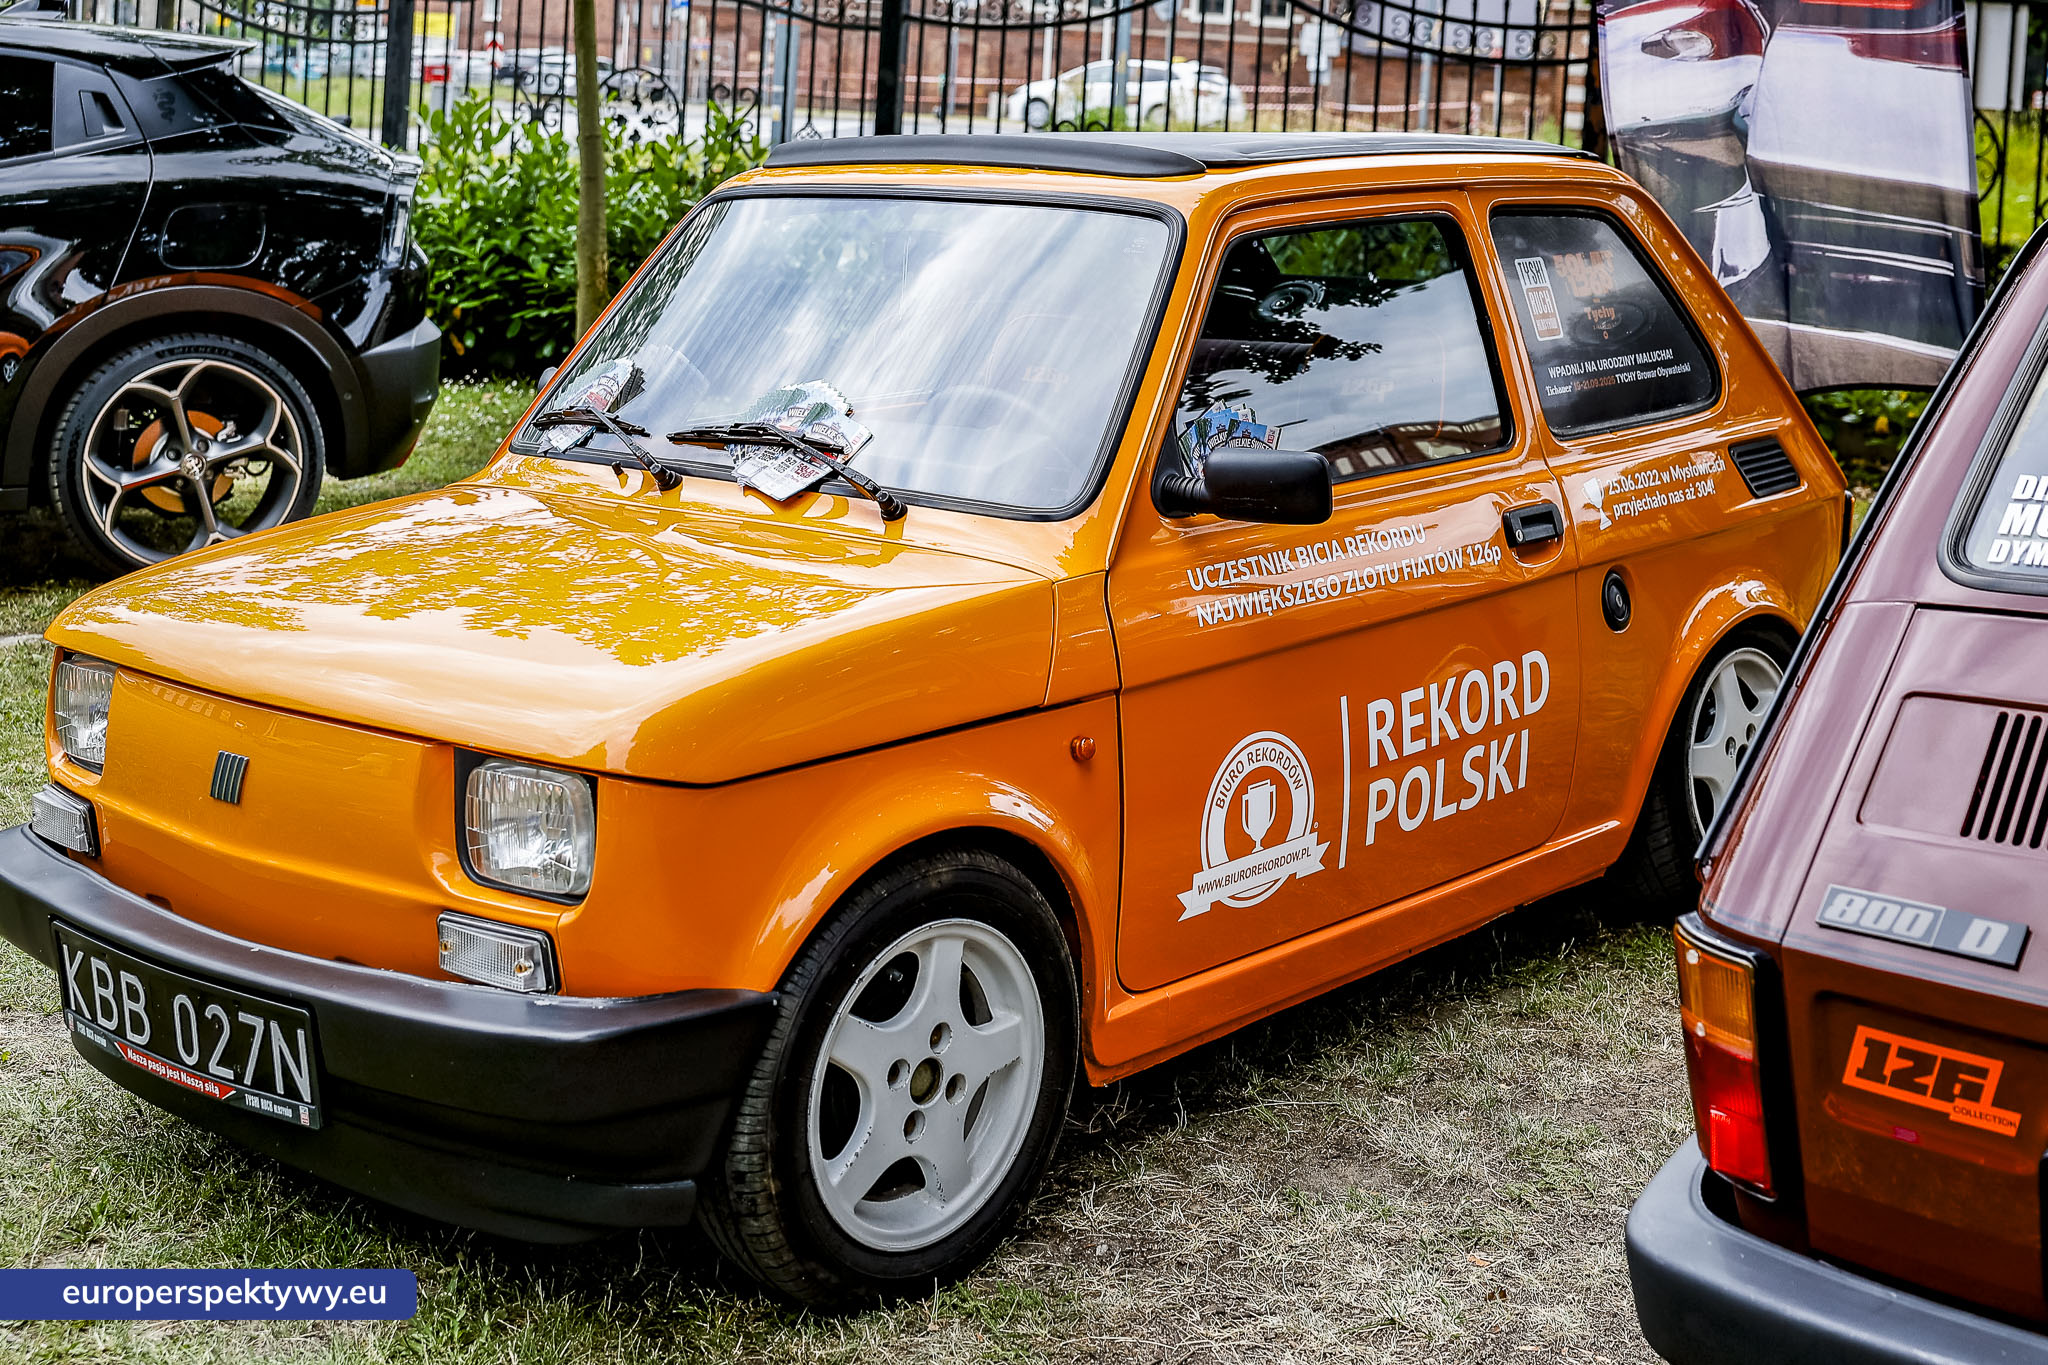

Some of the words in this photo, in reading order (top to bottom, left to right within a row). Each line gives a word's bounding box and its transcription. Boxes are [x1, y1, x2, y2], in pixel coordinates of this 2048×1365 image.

[1528, 290, 1554, 315] RUCH
[1583, 305, 1615, 323] Tychy
[1548, 364, 1585, 379] WPADNIJ
[1585, 361, 1597, 374] NA
[1597, 354, 1636, 371] URODZINY
[1635, 349, 1674, 365] MALUCHA!
[1615, 371, 1637, 384] TYCHY
[1637, 368, 1657, 380] Browar
[1656, 362, 1691, 378] Obywatelski
[1606, 469, 1661, 495] 25.06.2022
[1660, 471, 1670, 483] w
[1669, 456, 1726, 483] Mysłowicach
[1612, 486, 1668, 520] przyjechało
[1667, 489, 1685, 505] nas
[1684, 484, 1695, 500] aż
[1695, 478, 1716, 498] 304!
[1186, 548, 1293, 591] UCZESTNIK
[1294, 538, 1346, 569] BICIA
[1345, 523, 1427, 558] REKORDU
[1195, 577, 1342, 628] NAJWIĘKSZEGO
[1345, 561, 1400, 594] ZLOTU
[1402, 544, 1464, 581] FIATÓW
[1466, 541, 1502, 567] 126p
[1367, 650, 1550, 769] REKORD
[1215, 759, 1245, 810] BIURO
[1247, 746, 1304, 791] REKORDÓW
[1365, 728, 1529, 847] POLSKI
[1197, 846, 1312, 896] WWW.BIUROREKORDOW.PL
[1824, 893, 1935, 939] 800
[1958, 918, 2009, 956] D
[62, 944, 151, 1046] KBB
[173, 994, 312, 1104] 027N
[127, 1047, 147, 1066] Nasza
[147, 1059, 166, 1075] pasja
[166, 1065, 180, 1080] jest
[180, 1071, 204, 1092] Naszą
[204, 1081, 219, 1098] siłą
[1952, 1103, 2019, 1129] COLLECTION
